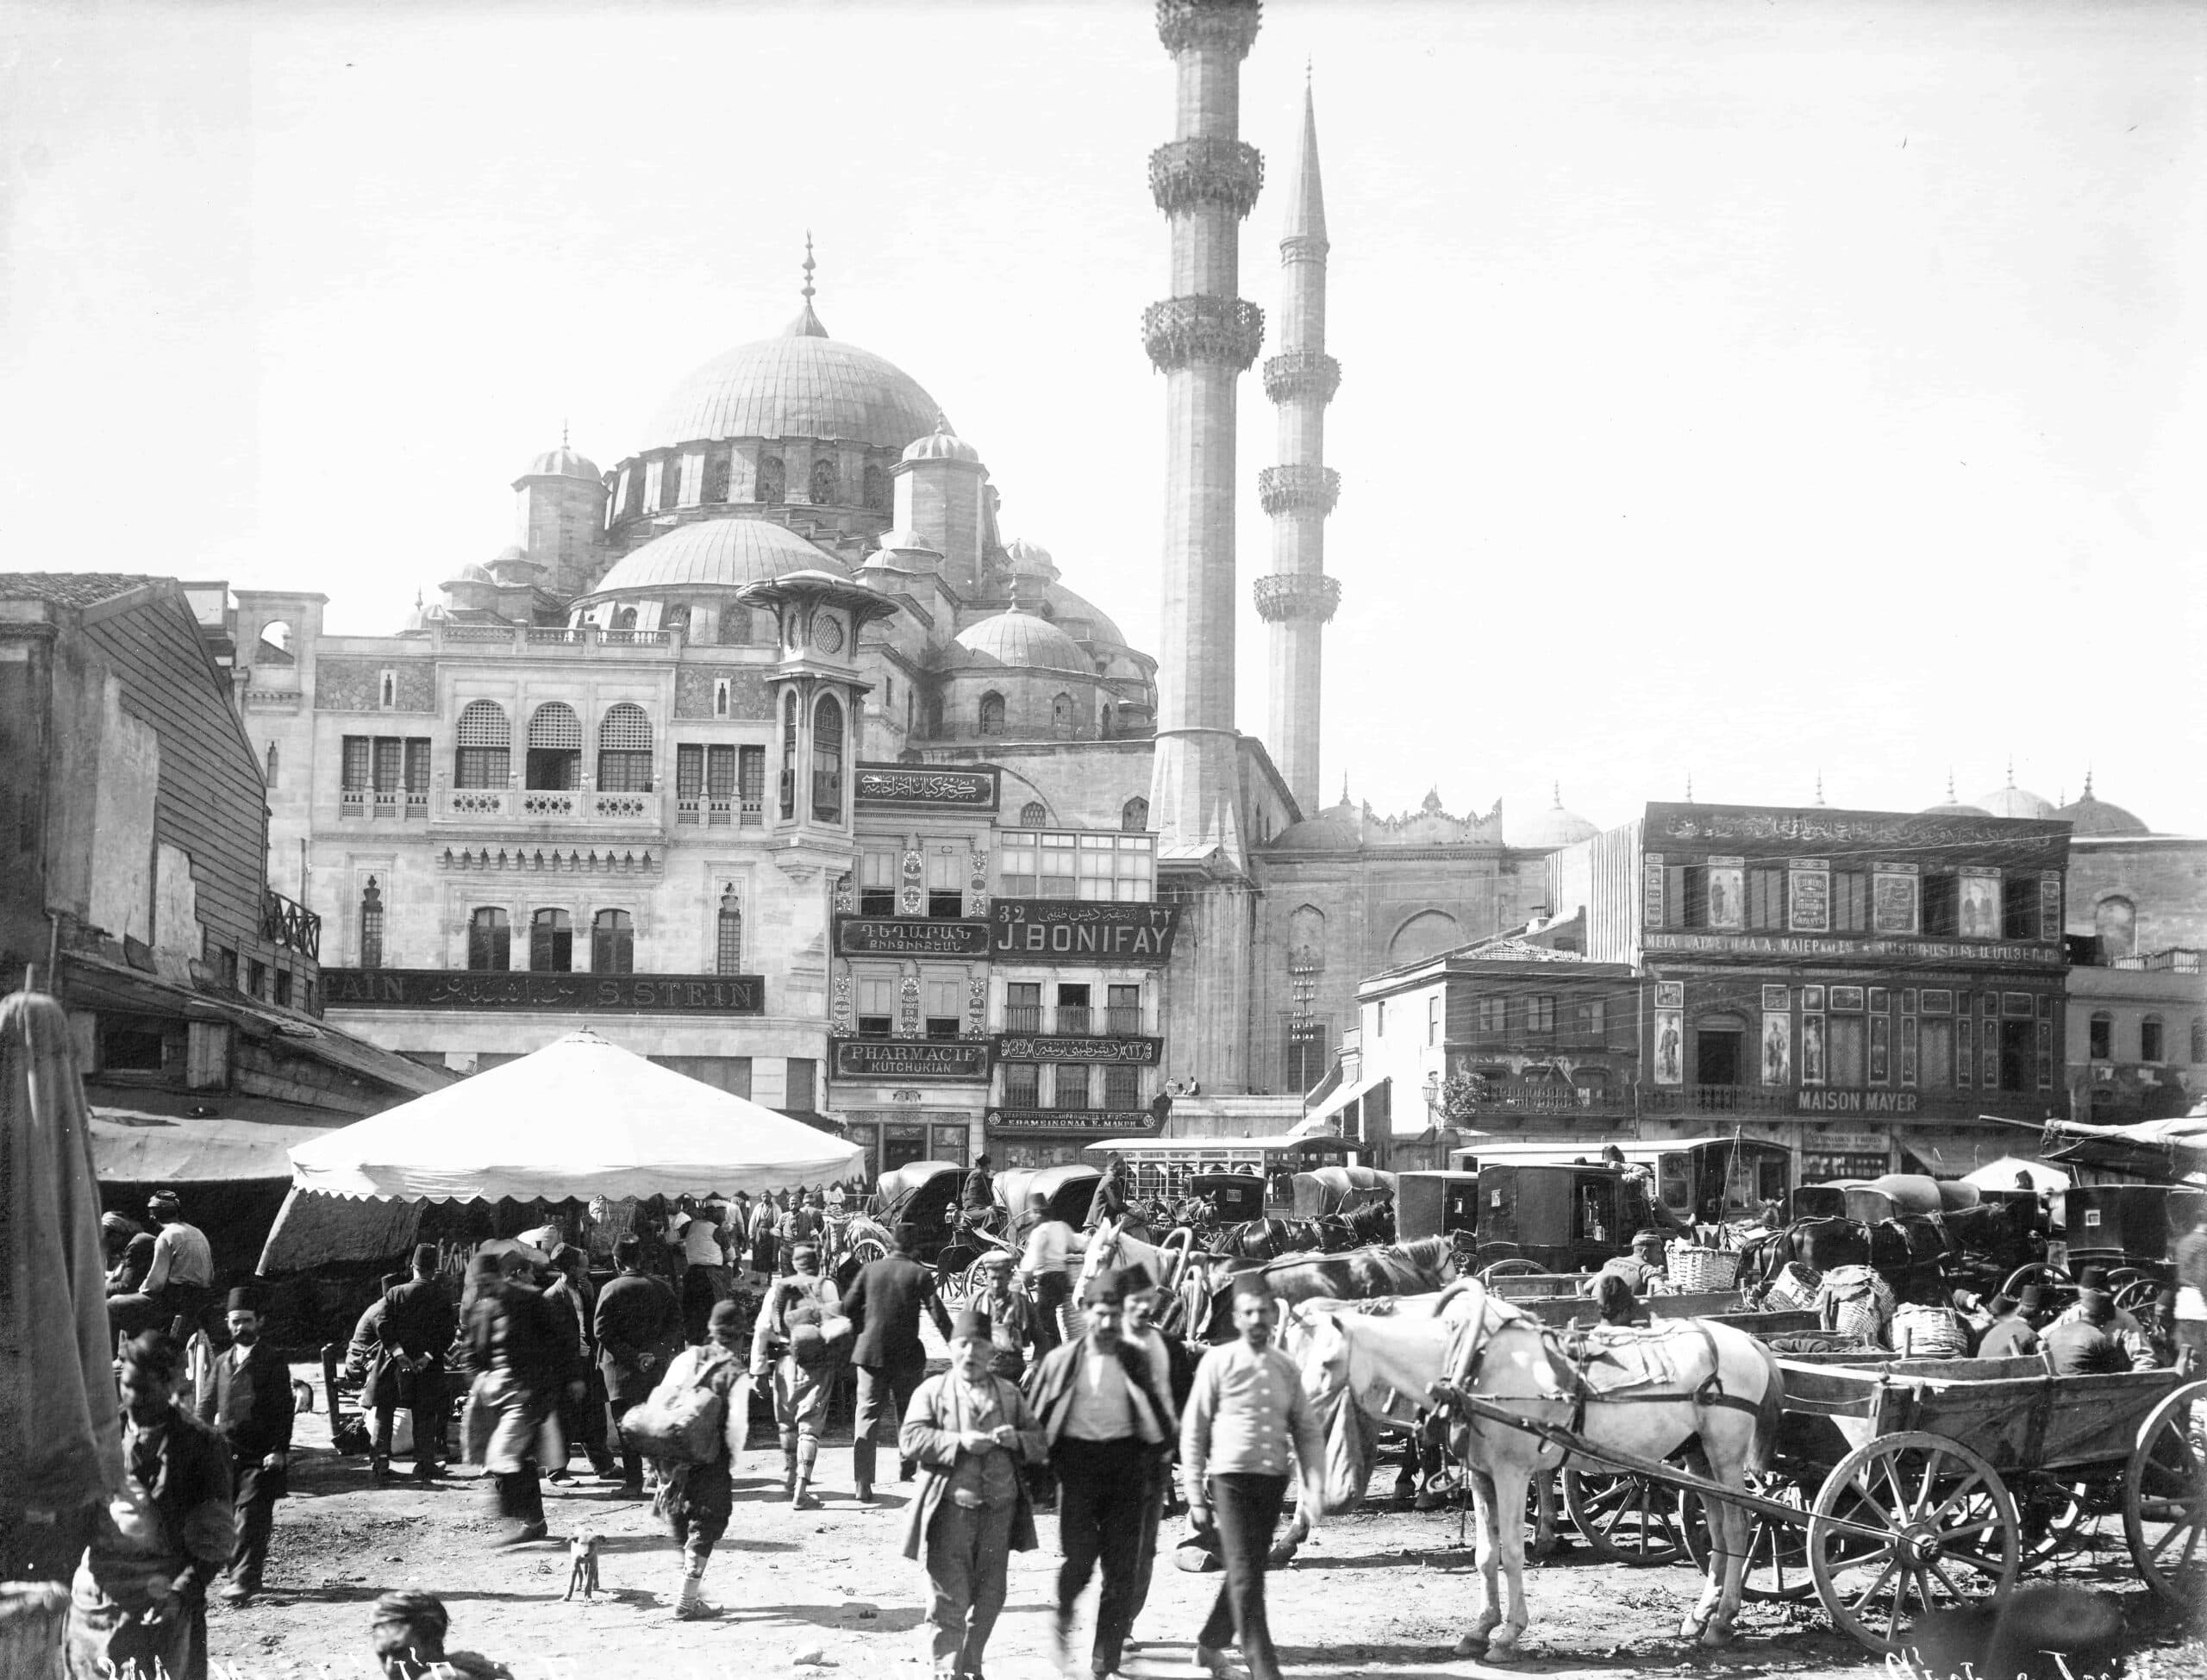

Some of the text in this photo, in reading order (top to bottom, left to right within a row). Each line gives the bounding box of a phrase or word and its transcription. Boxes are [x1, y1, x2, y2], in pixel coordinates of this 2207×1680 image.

[999, 905, 1026, 923] 32
[851, 1046, 976, 1062] PHARMACIE
[1012, 1041, 1026, 1054] 32
[872, 1061, 951, 1073] KUTCHUKIAN
[1798, 1090, 1917, 1111] MAISON MAYER
